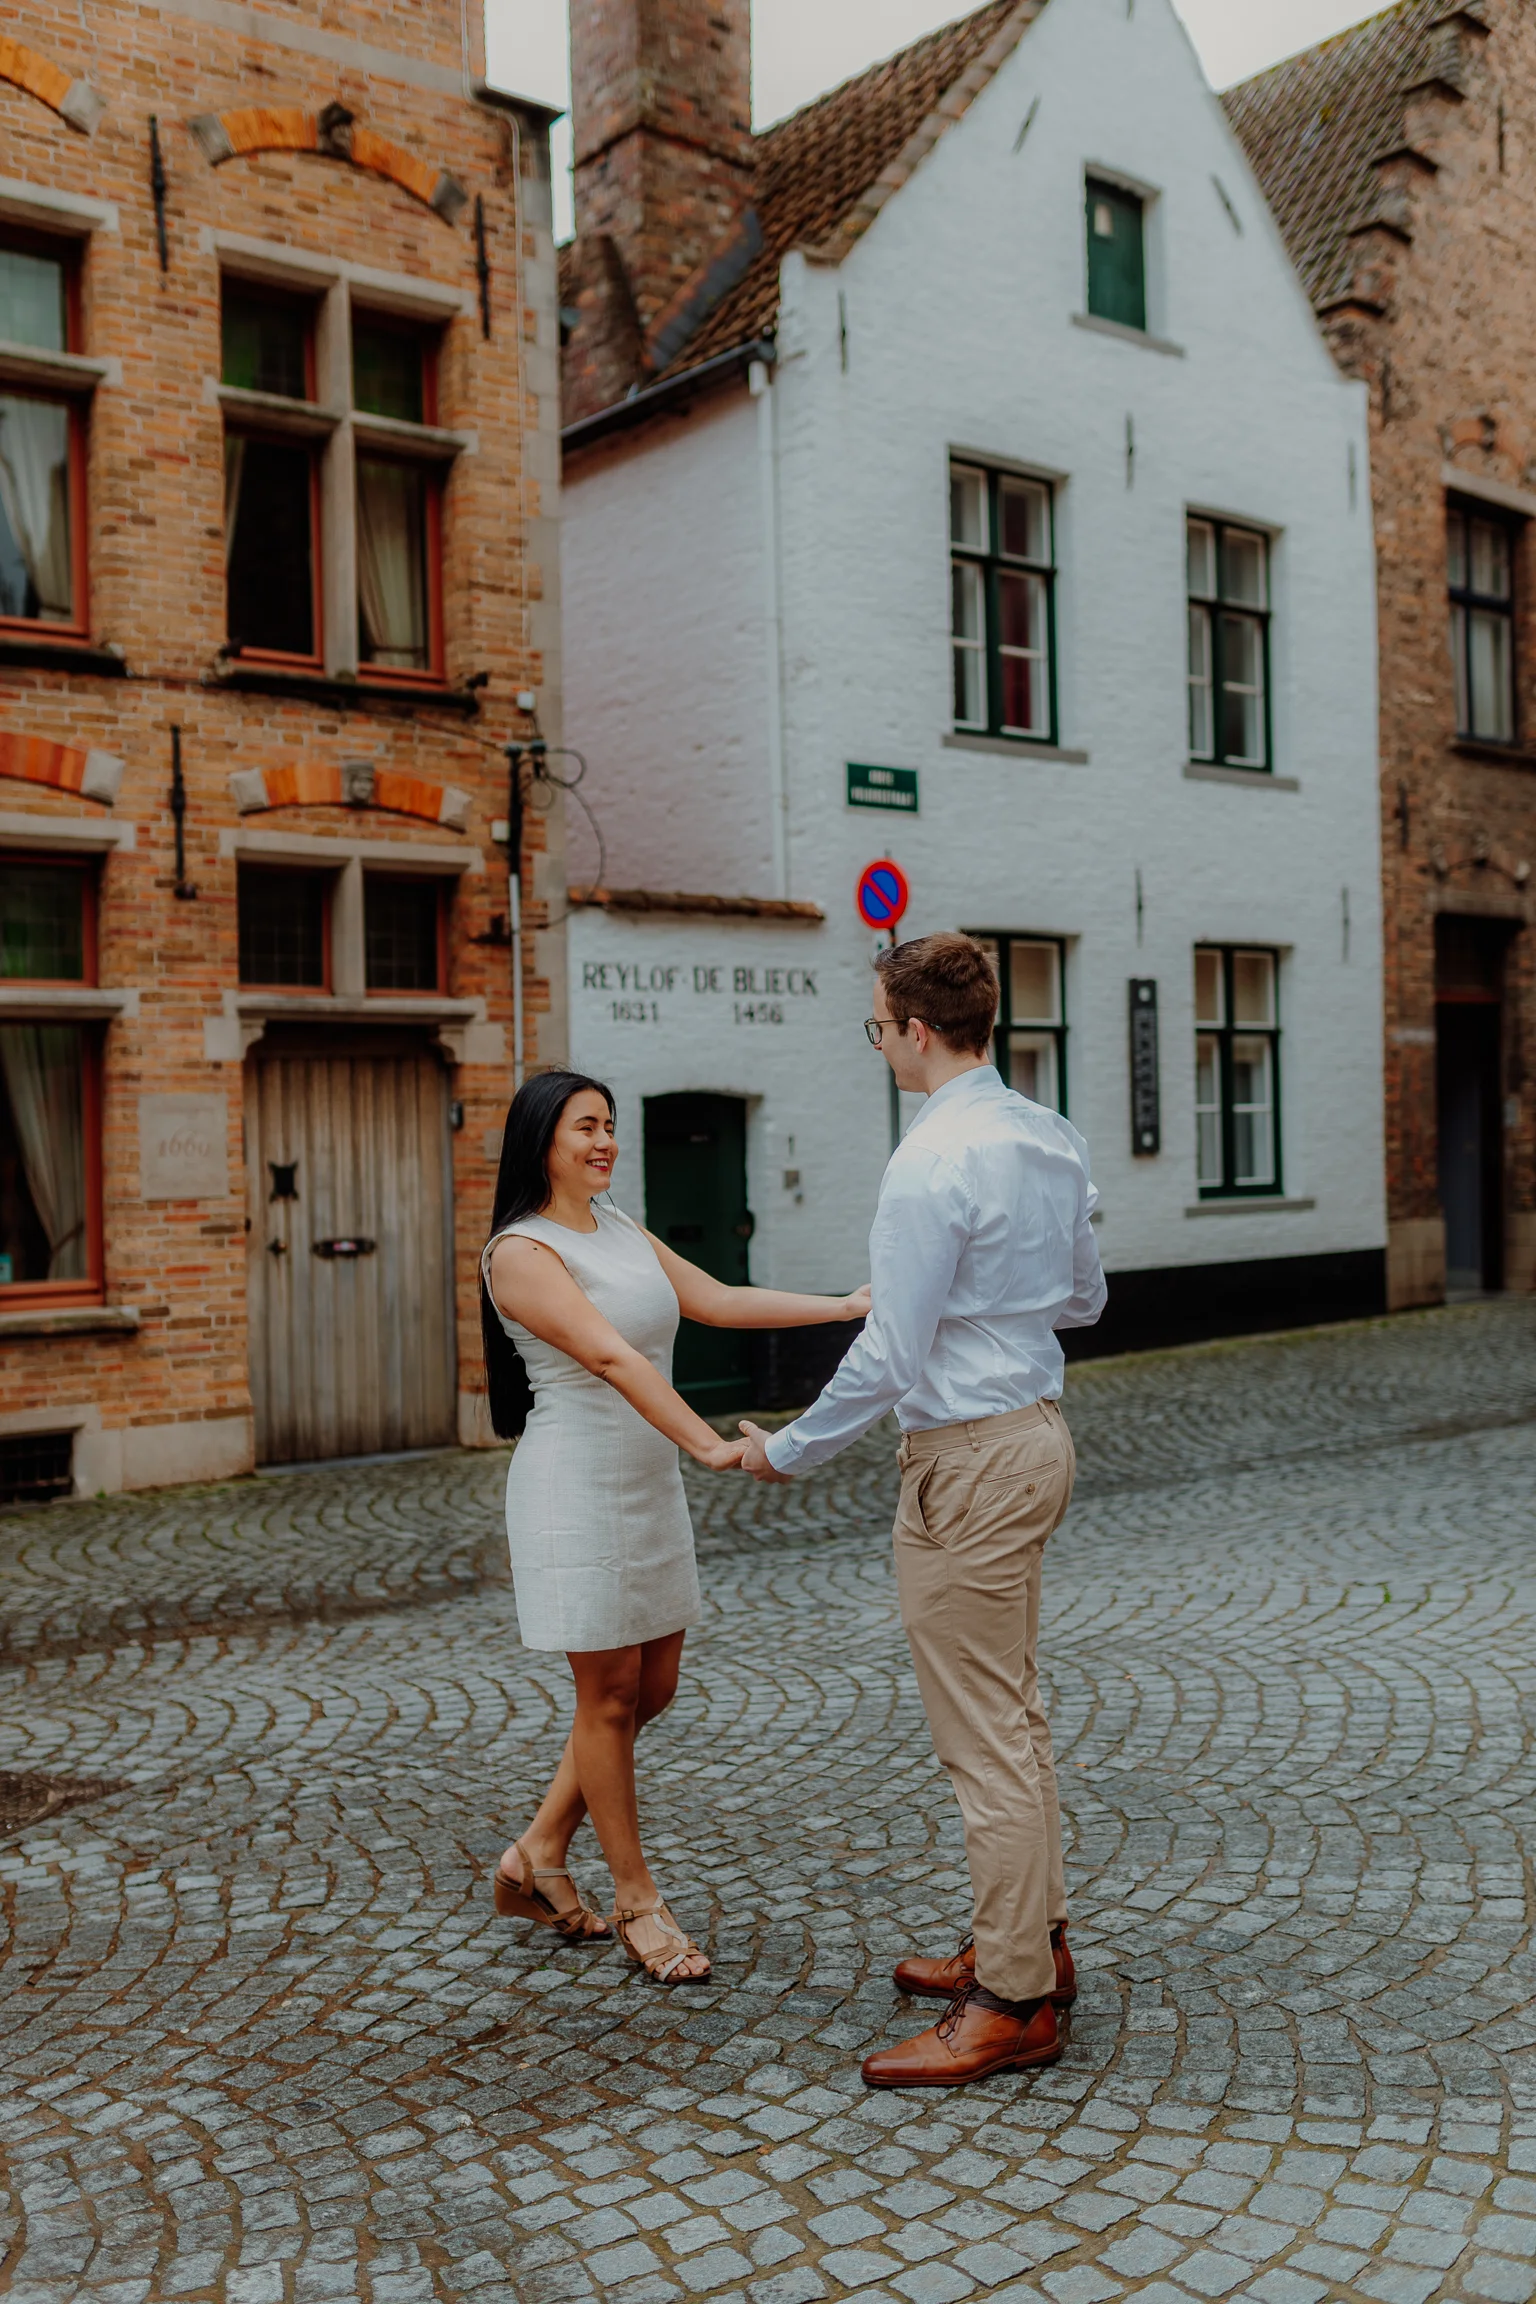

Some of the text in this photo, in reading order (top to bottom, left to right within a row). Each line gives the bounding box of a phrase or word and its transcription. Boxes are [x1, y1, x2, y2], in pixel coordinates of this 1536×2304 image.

[583, 963, 818, 996] REYLOF DE BLIECK
